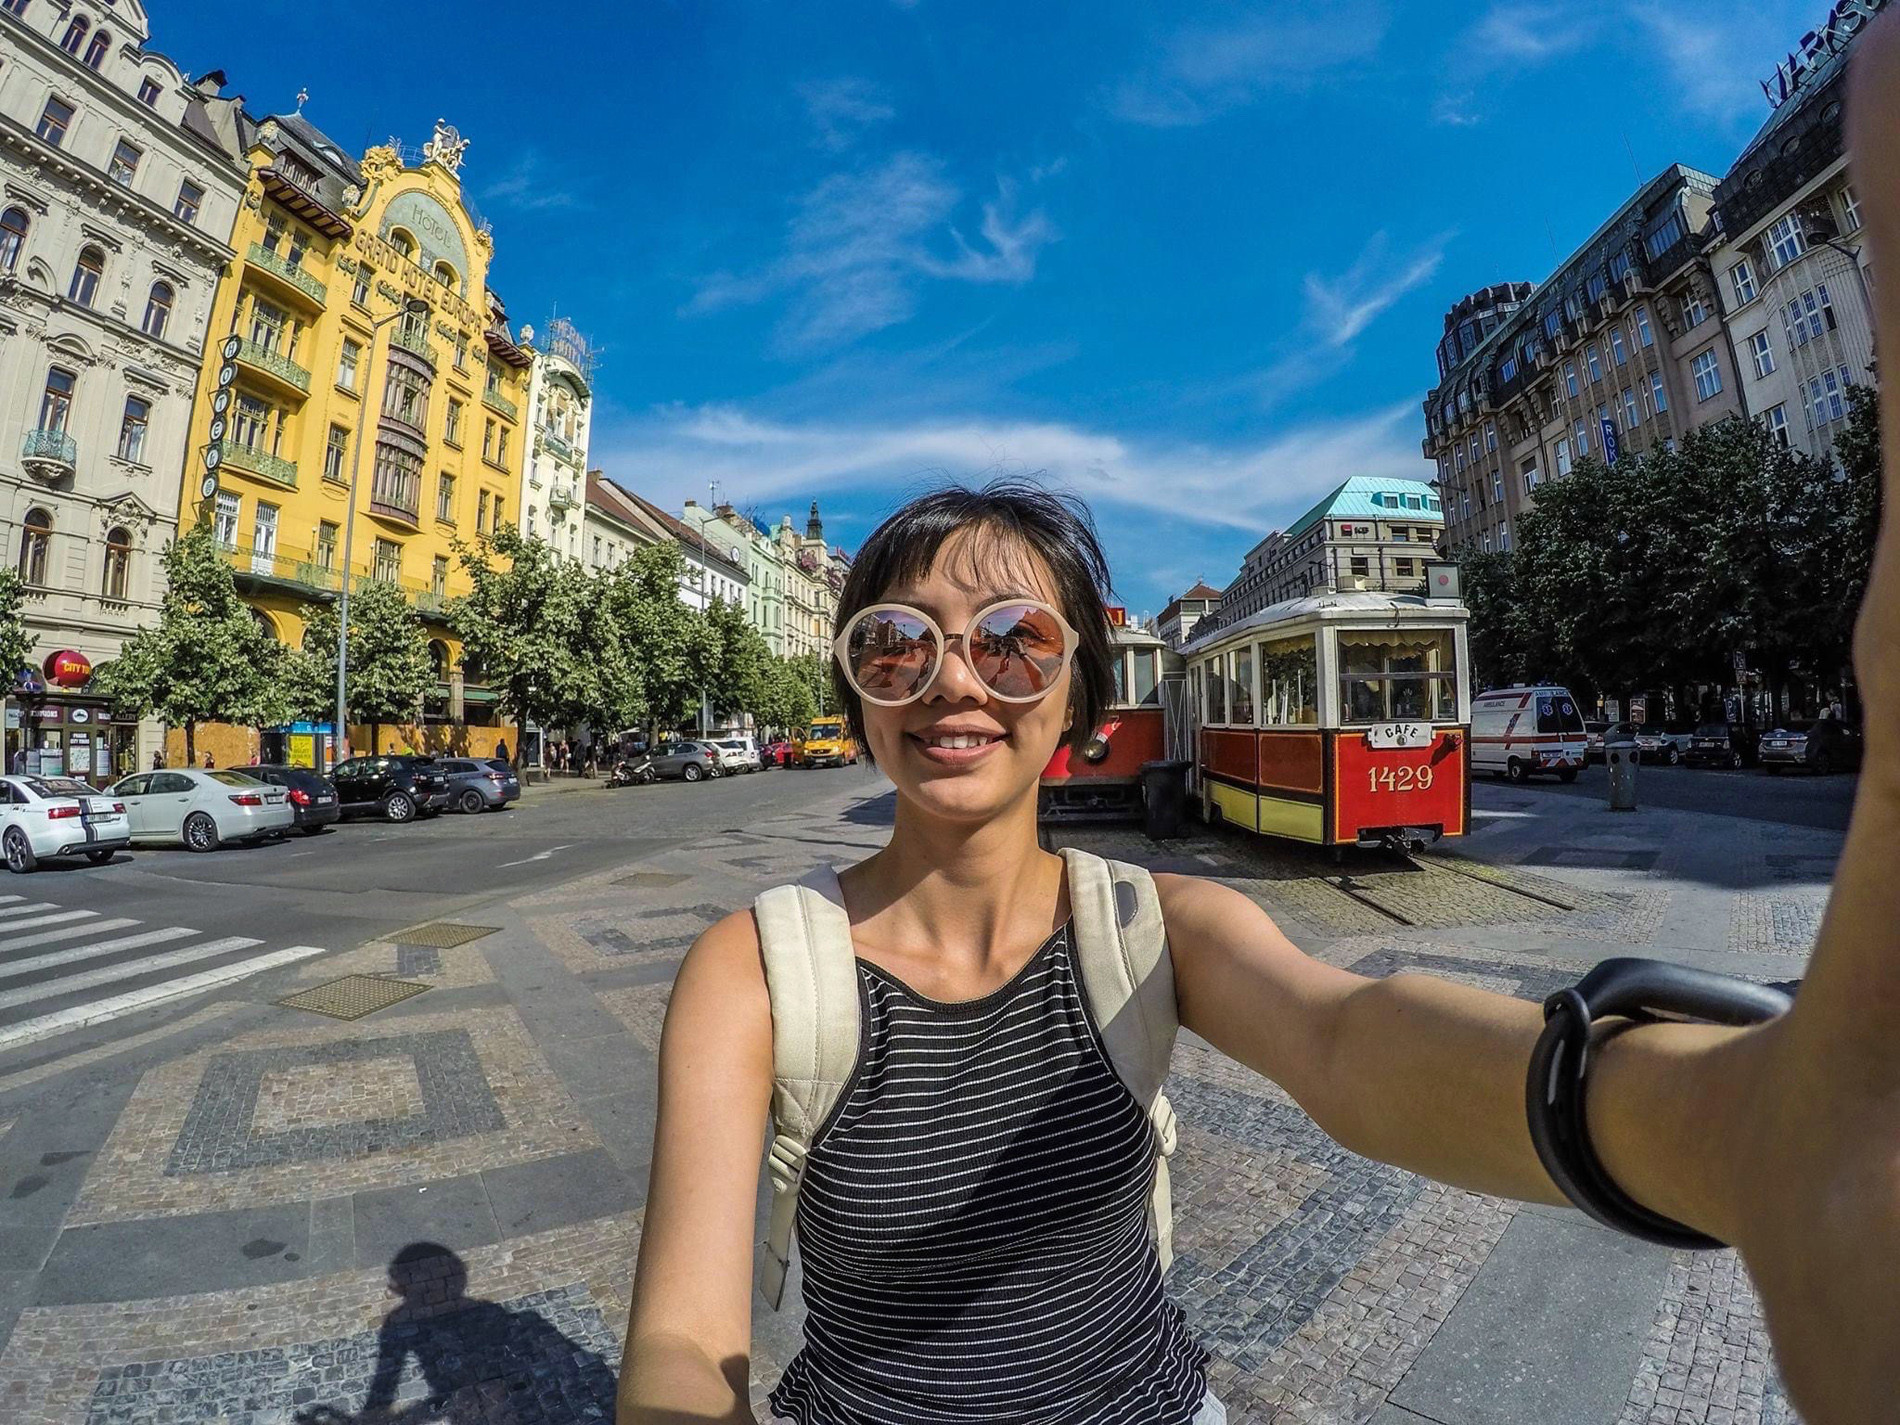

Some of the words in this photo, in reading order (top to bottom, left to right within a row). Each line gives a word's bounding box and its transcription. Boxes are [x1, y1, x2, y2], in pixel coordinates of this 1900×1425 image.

[411, 204, 451, 248] HOTEL
[355, 228, 399, 274] GRAND
[401, 265, 437, 305] HOTEL
[63, 662, 81, 674] CITY
[115, 713, 137, 721] ALLERY
[1385, 724, 1418, 738] CAFE
[1368, 764, 1433, 792] 1429
